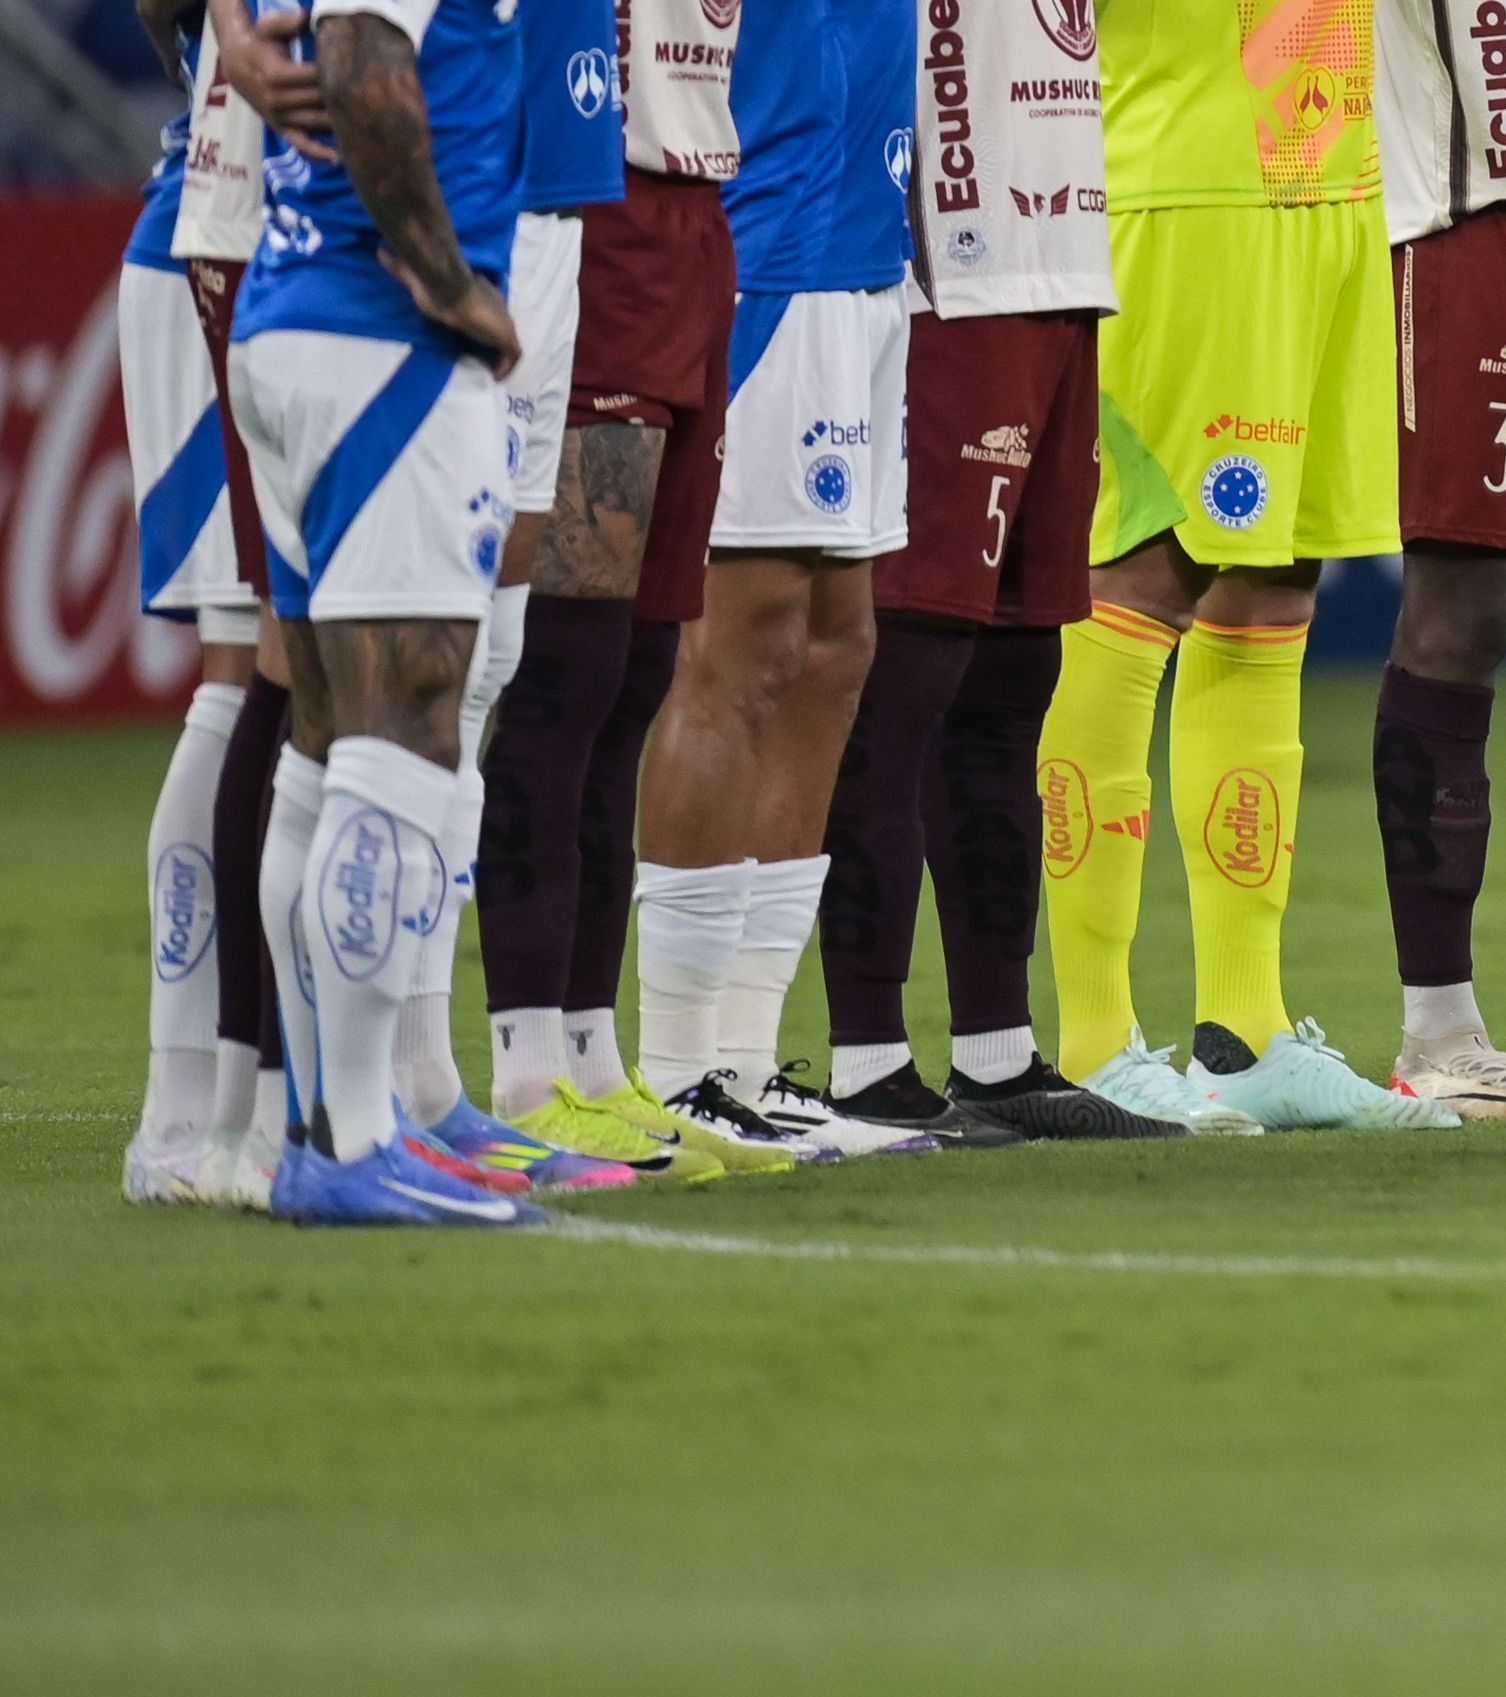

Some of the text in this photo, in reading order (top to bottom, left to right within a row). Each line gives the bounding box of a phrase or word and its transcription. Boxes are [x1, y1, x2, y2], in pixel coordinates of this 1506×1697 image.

[1010, 79, 1090, 102] MUSHUC
[1234, 415, 1306, 446] betfair
[1208, 456, 1264, 479] CRUZEIRO
[982, 475, 1011, 568] 5
[1203, 485, 1267, 527] ESPORTE CLUBE
[1042, 766, 1076, 864] Kodilar
[1226, 777, 1265, 874] Kodilar
[338, 820, 389, 959] Kodilar
